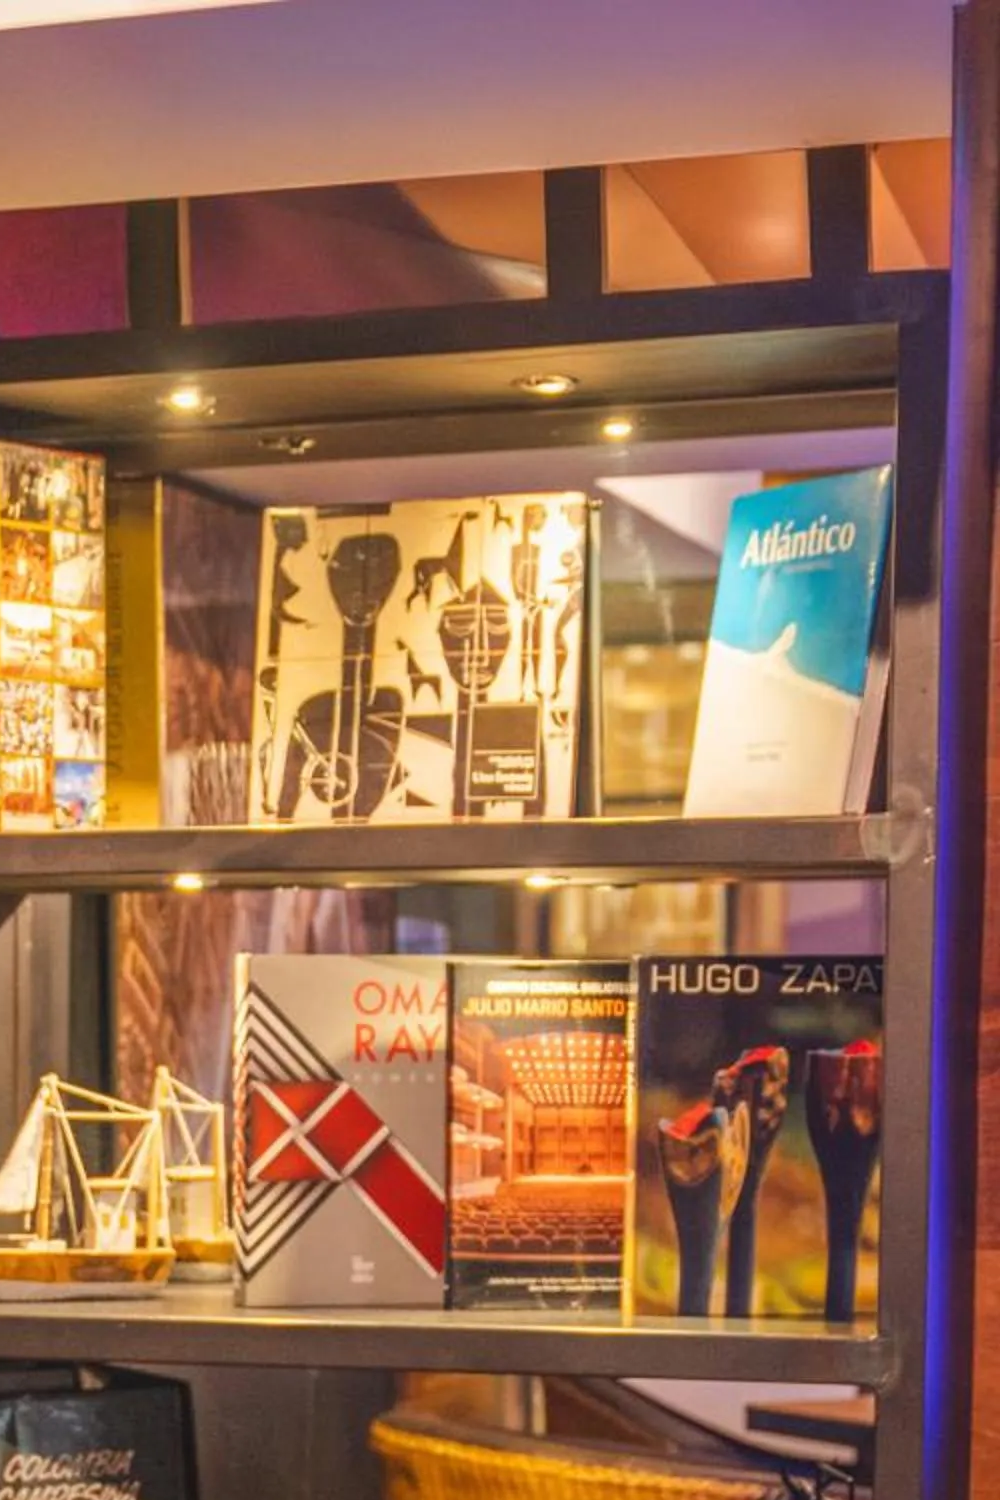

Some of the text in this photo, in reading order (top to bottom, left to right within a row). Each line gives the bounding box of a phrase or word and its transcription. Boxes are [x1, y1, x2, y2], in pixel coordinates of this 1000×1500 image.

[740, 514, 856, 569] Atlántico
[651, 963, 760, 993] HUGO
[463, 997, 625, 1019] JULIO MARIO SANTO
[355, 1023, 442, 1063] RAY
[3, 1449, 136, 1483] COLOMBIA
